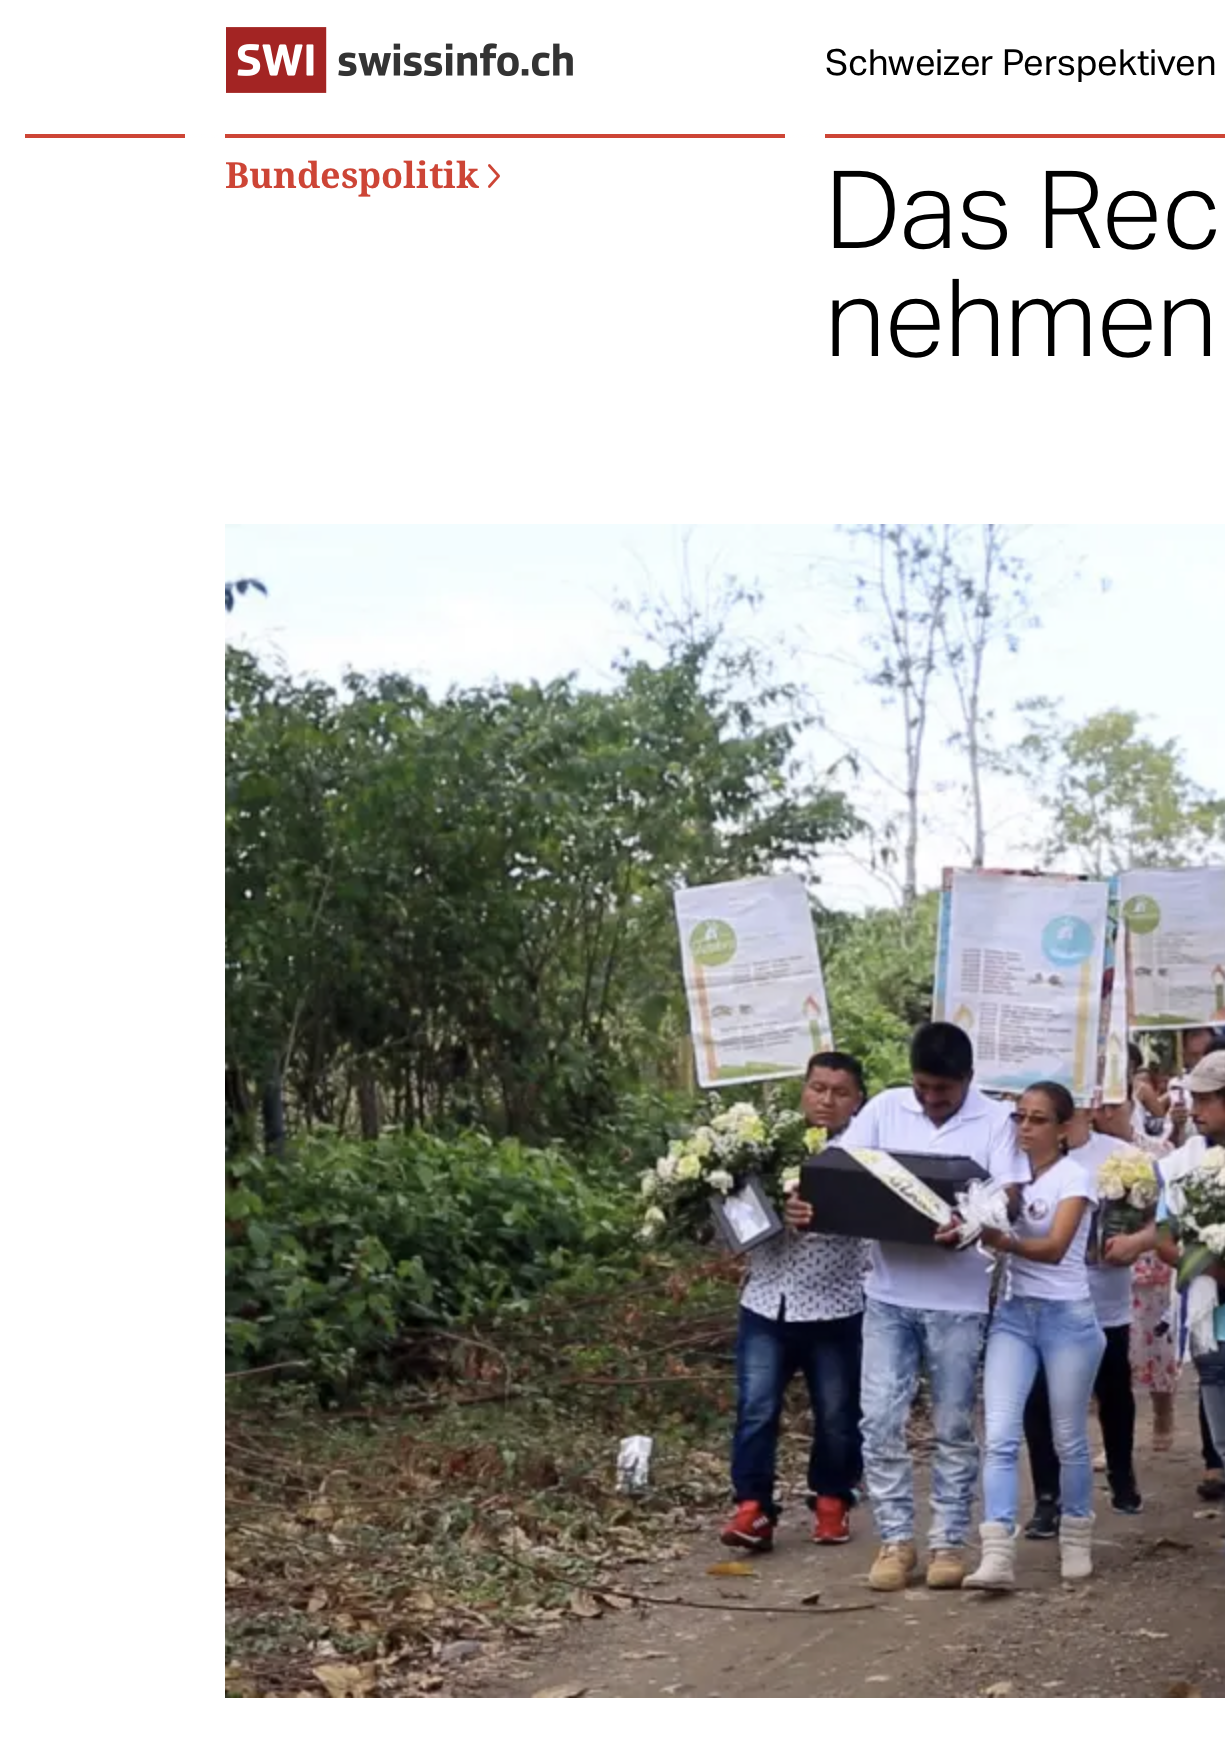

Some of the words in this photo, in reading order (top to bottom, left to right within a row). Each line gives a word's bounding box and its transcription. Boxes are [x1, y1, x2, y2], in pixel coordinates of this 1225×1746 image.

[237, 43, 315, 77] SWI
[338, 43, 573, 77] swissinfo.ch
[826, 48, 993, 76] Schweizer
[1005, 48, 1215, 82] Perspektiven
[226, 160, 479, 197] Bundespolitik
[834, 171, 1007, 250] Das
[832, 279, 1210, 358] nehmen
